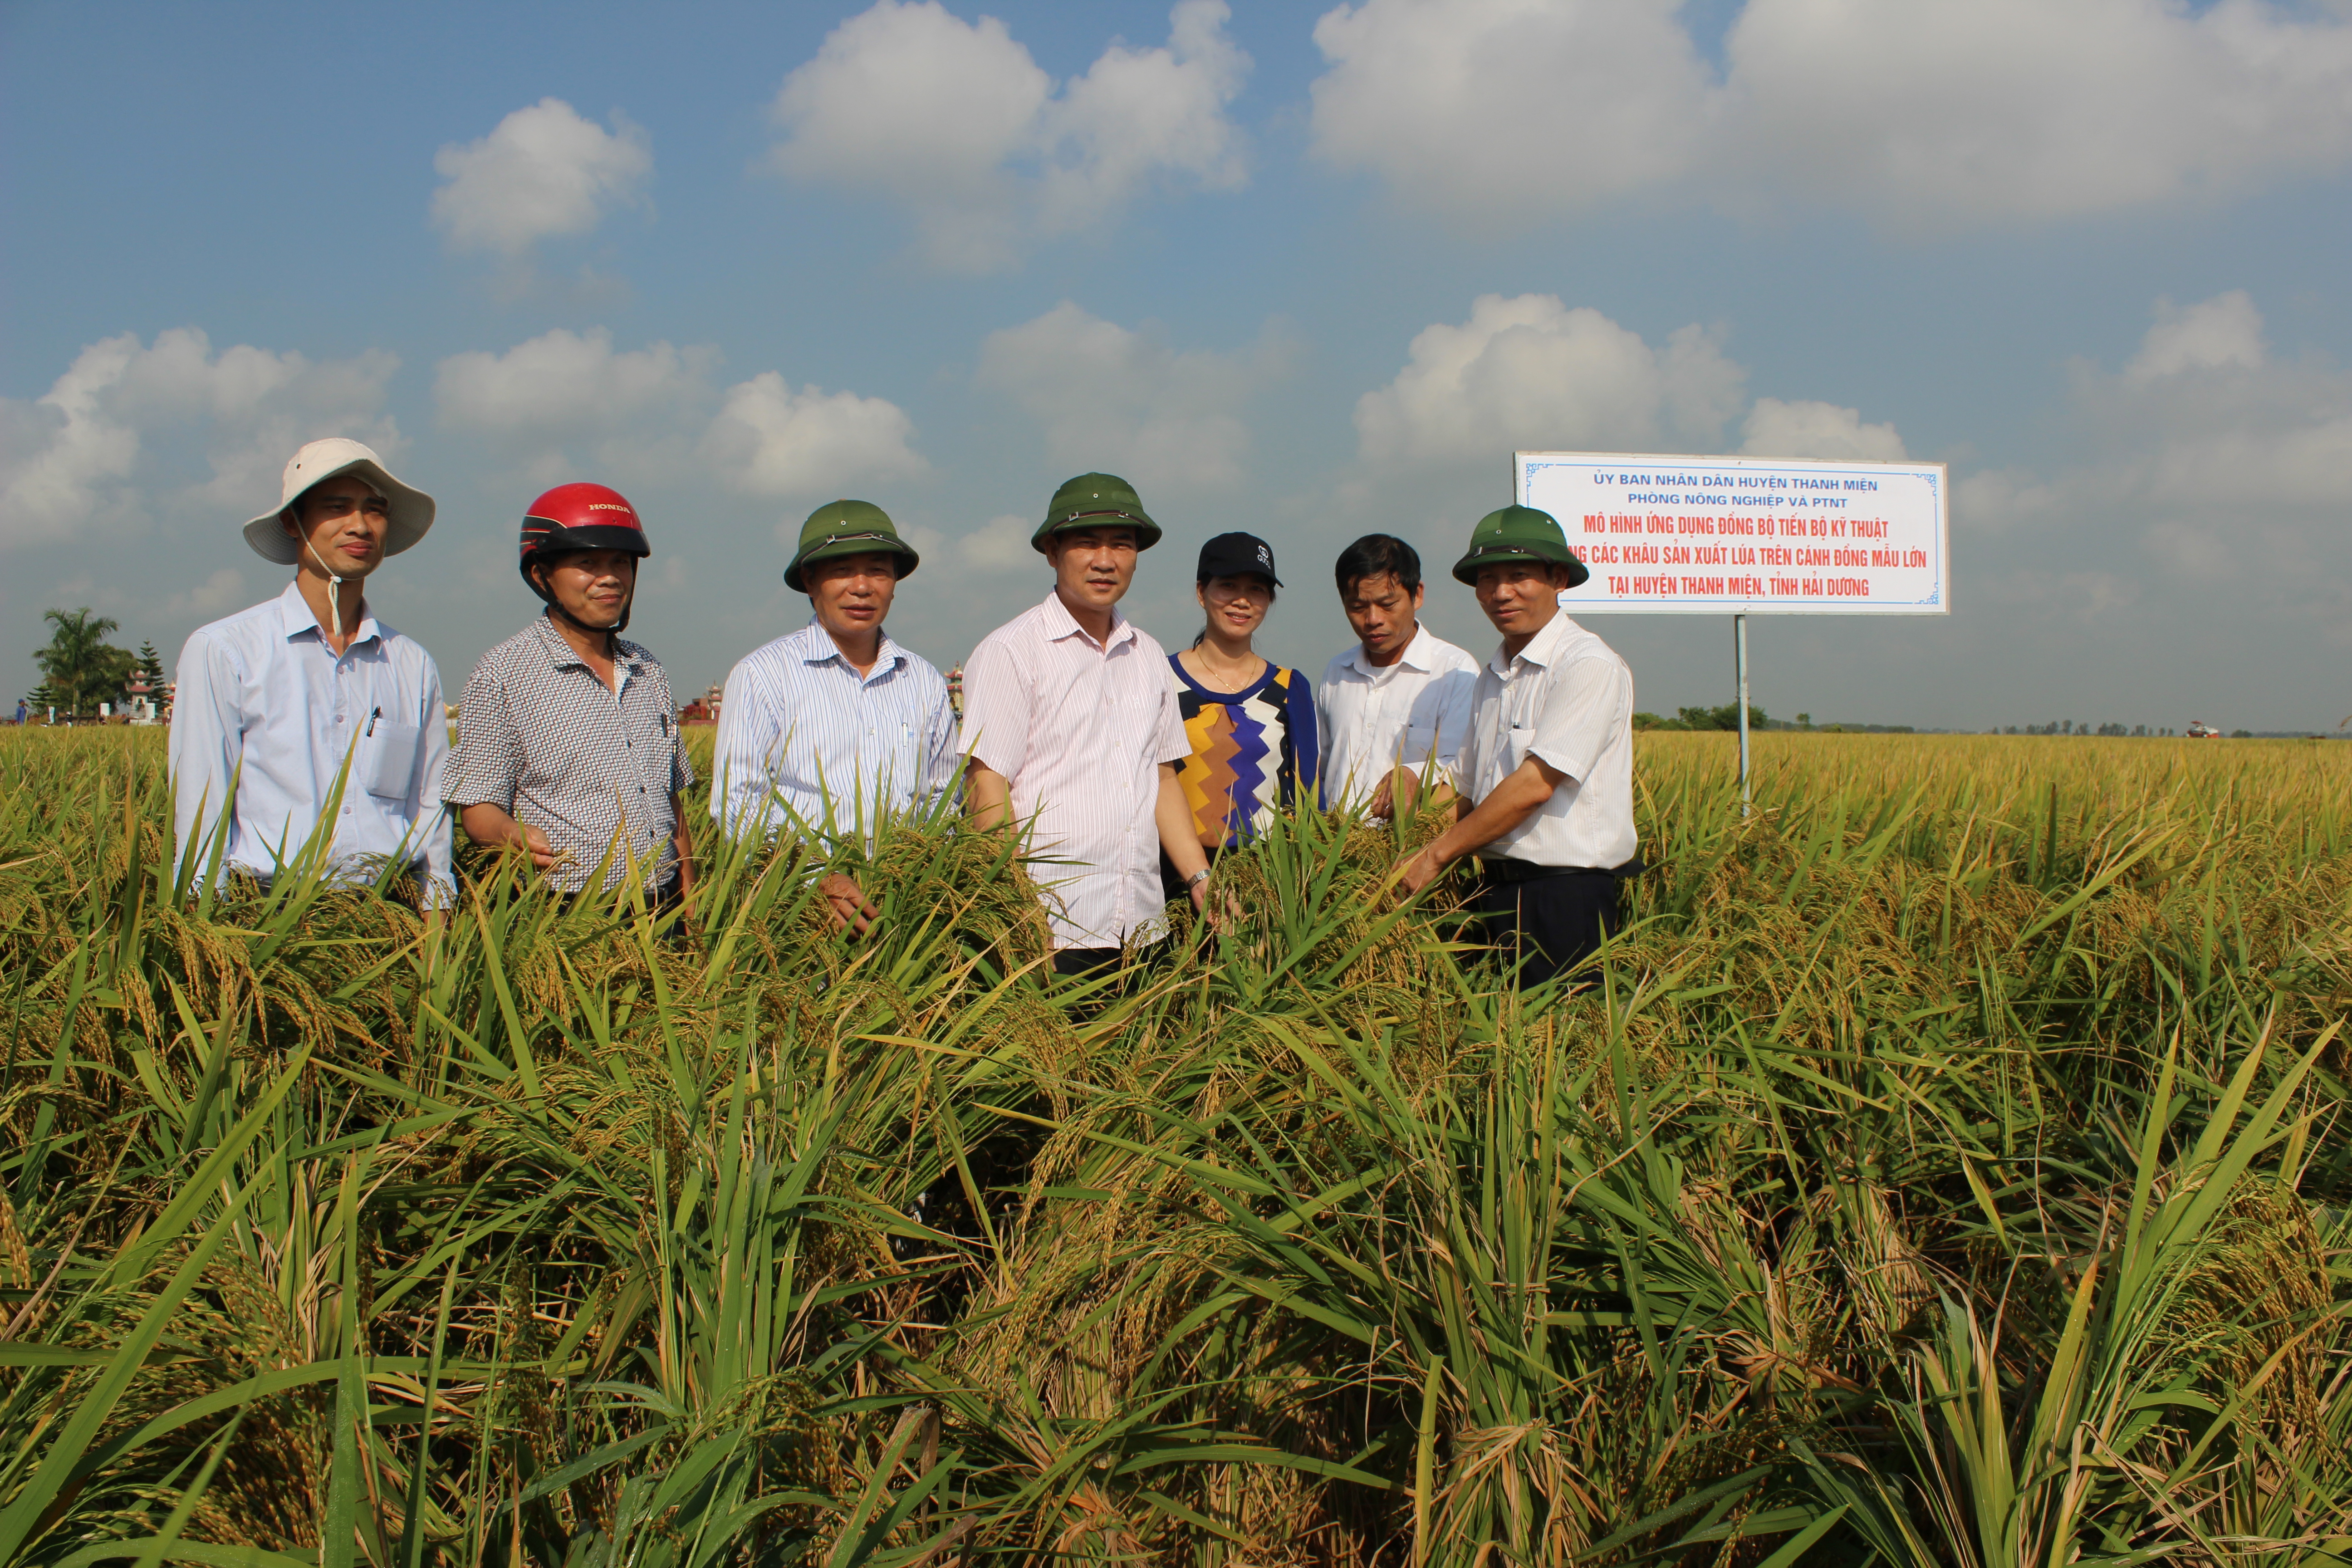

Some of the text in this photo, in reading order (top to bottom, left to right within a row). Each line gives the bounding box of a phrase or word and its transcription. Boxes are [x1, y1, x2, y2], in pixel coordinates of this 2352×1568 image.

[1594, 469, 1877, 493] ỦY BAN NHÂN DÂN HUYỆN THANH MIỆN
[588, 504, 631, 514] HONDA
[1628, 491, 1847, 509] PHÒNG NÔNG NGHIỆP VÀ PTNT
[1584, 510, 1888, 542] MÔ HÌNH ỨNG DỤNG ĐỒNG BỘ TIẾN BỘ KỸ THUẬT
[1592, 542, 1618, 564] CÁC
[1623, 542, 1659, 564] KHÂU
[1663, 539, 1690, 564] SẢN
[1695, 541, 1728, 564] XUẤT
[1732, 544, 1756, 565] LÚA
[1759, 544, 1792, 565] TRÊN
[1796, 545, 1830, 566] CÁNH
[1834, 544, 1868, 567] ĐỒNG
[1872, 543, 1899, 567] MẪU
[1903, 546, 1926, 568] LỚN
[1608, 571, 1869, 598] TẠI HUYỆN THANH MIỆN, TỈNH HẢI DƯƠNG
